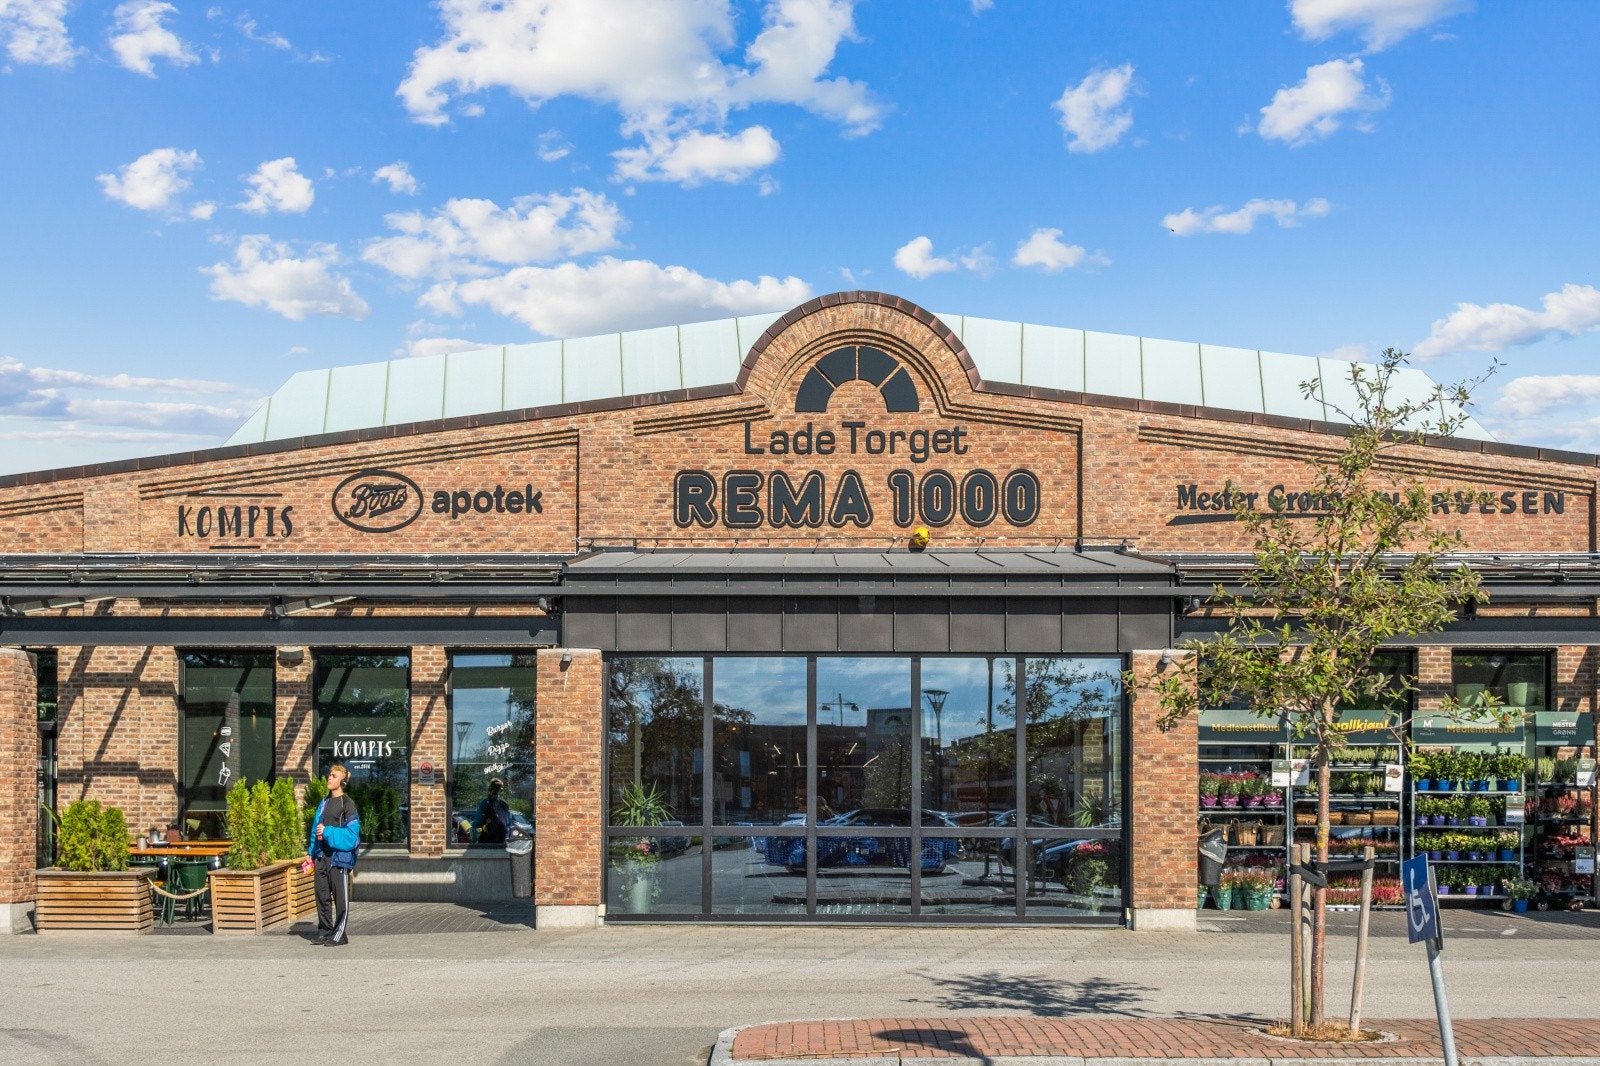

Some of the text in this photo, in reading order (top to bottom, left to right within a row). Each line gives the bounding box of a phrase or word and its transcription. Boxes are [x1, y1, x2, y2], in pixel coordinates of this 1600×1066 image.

[744, 421, 968, 463] Lade Torget
[344, 484, 408, 518] Boots
[431, 483, 543, 520] apotek
[673, 468, 1041, 529] REMA 1000
[1176, 484, 1259, 511] Mester
[1382, 491, 1565, 515] NRVESEN
[178, 505, 294, 538] KOMPIS
[486, 720, 513, 736] Burger
[1211, 723, 1281, 733] Medlemstilbud
[1446, 724, 1516, 734] Medlemstilbud
[333, 740, 393, 758] KOMPIS
[488, 743, 510, 756] Pizza
